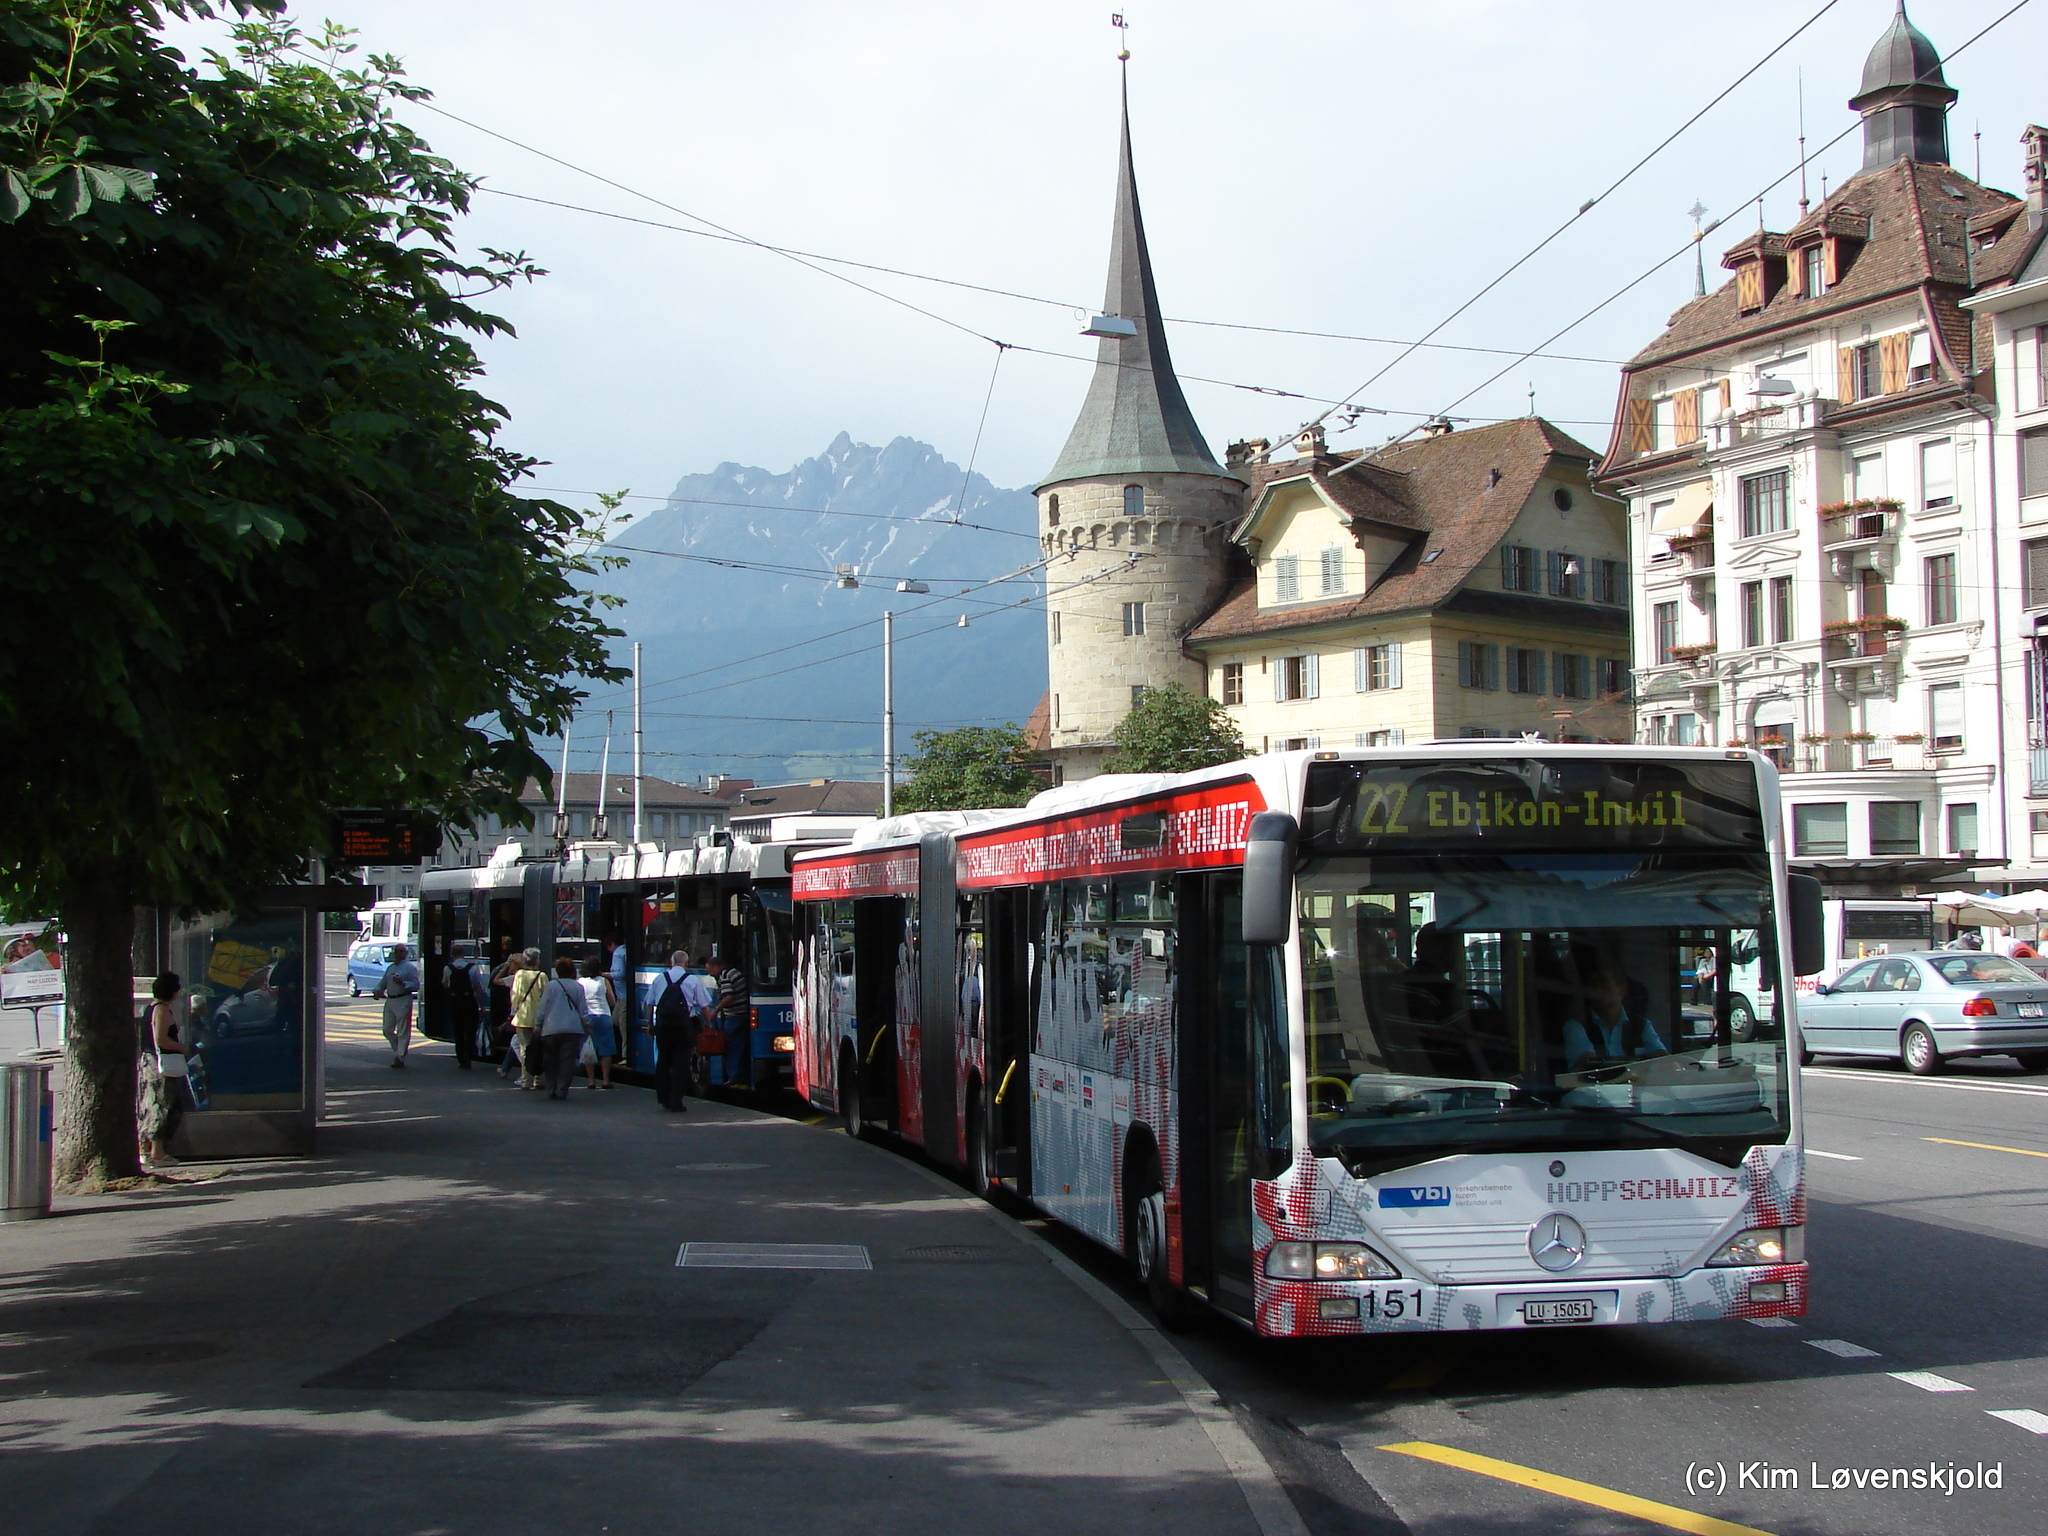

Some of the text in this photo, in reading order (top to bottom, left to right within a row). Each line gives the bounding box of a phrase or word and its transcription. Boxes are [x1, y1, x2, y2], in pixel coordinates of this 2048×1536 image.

[1358, 782, 1686, 833] 22 Ebikon-Inwil
[1410, 1185, 1448, 1201] vbl
[1363, 1289, 1422, 1319] 151
[1530, 1302, 1588, 1318] LU 15051
